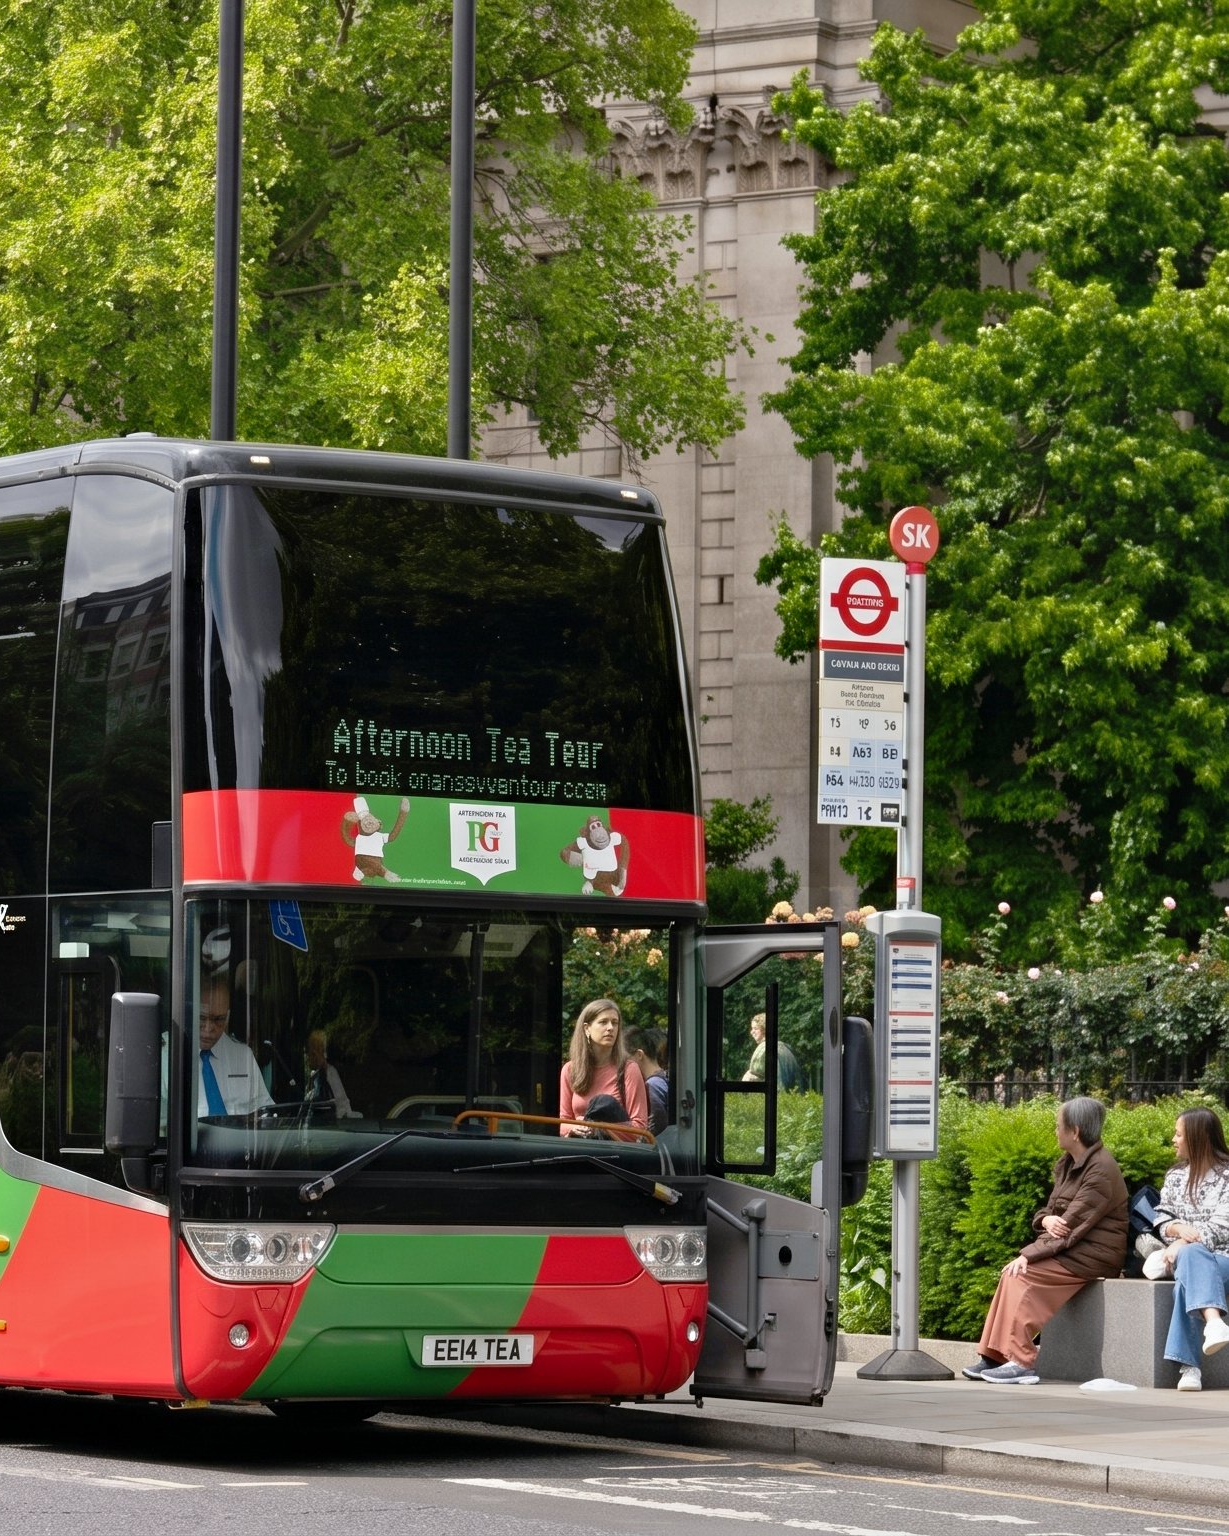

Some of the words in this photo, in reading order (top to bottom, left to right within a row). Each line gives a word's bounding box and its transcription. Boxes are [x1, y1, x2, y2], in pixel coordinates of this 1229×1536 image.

[901, 522, 931, 549] SK
[333, 718, 471, 761] Afternoon
[485, 727, 531, 765] Tea
[325, 760, 348, 785] To
[356, 761, 402, 788] book
[465, 820, 500, 852] PG
[434, 1338, 477, 1361] EE14
[484, 1338, 520, 1361] TEA
